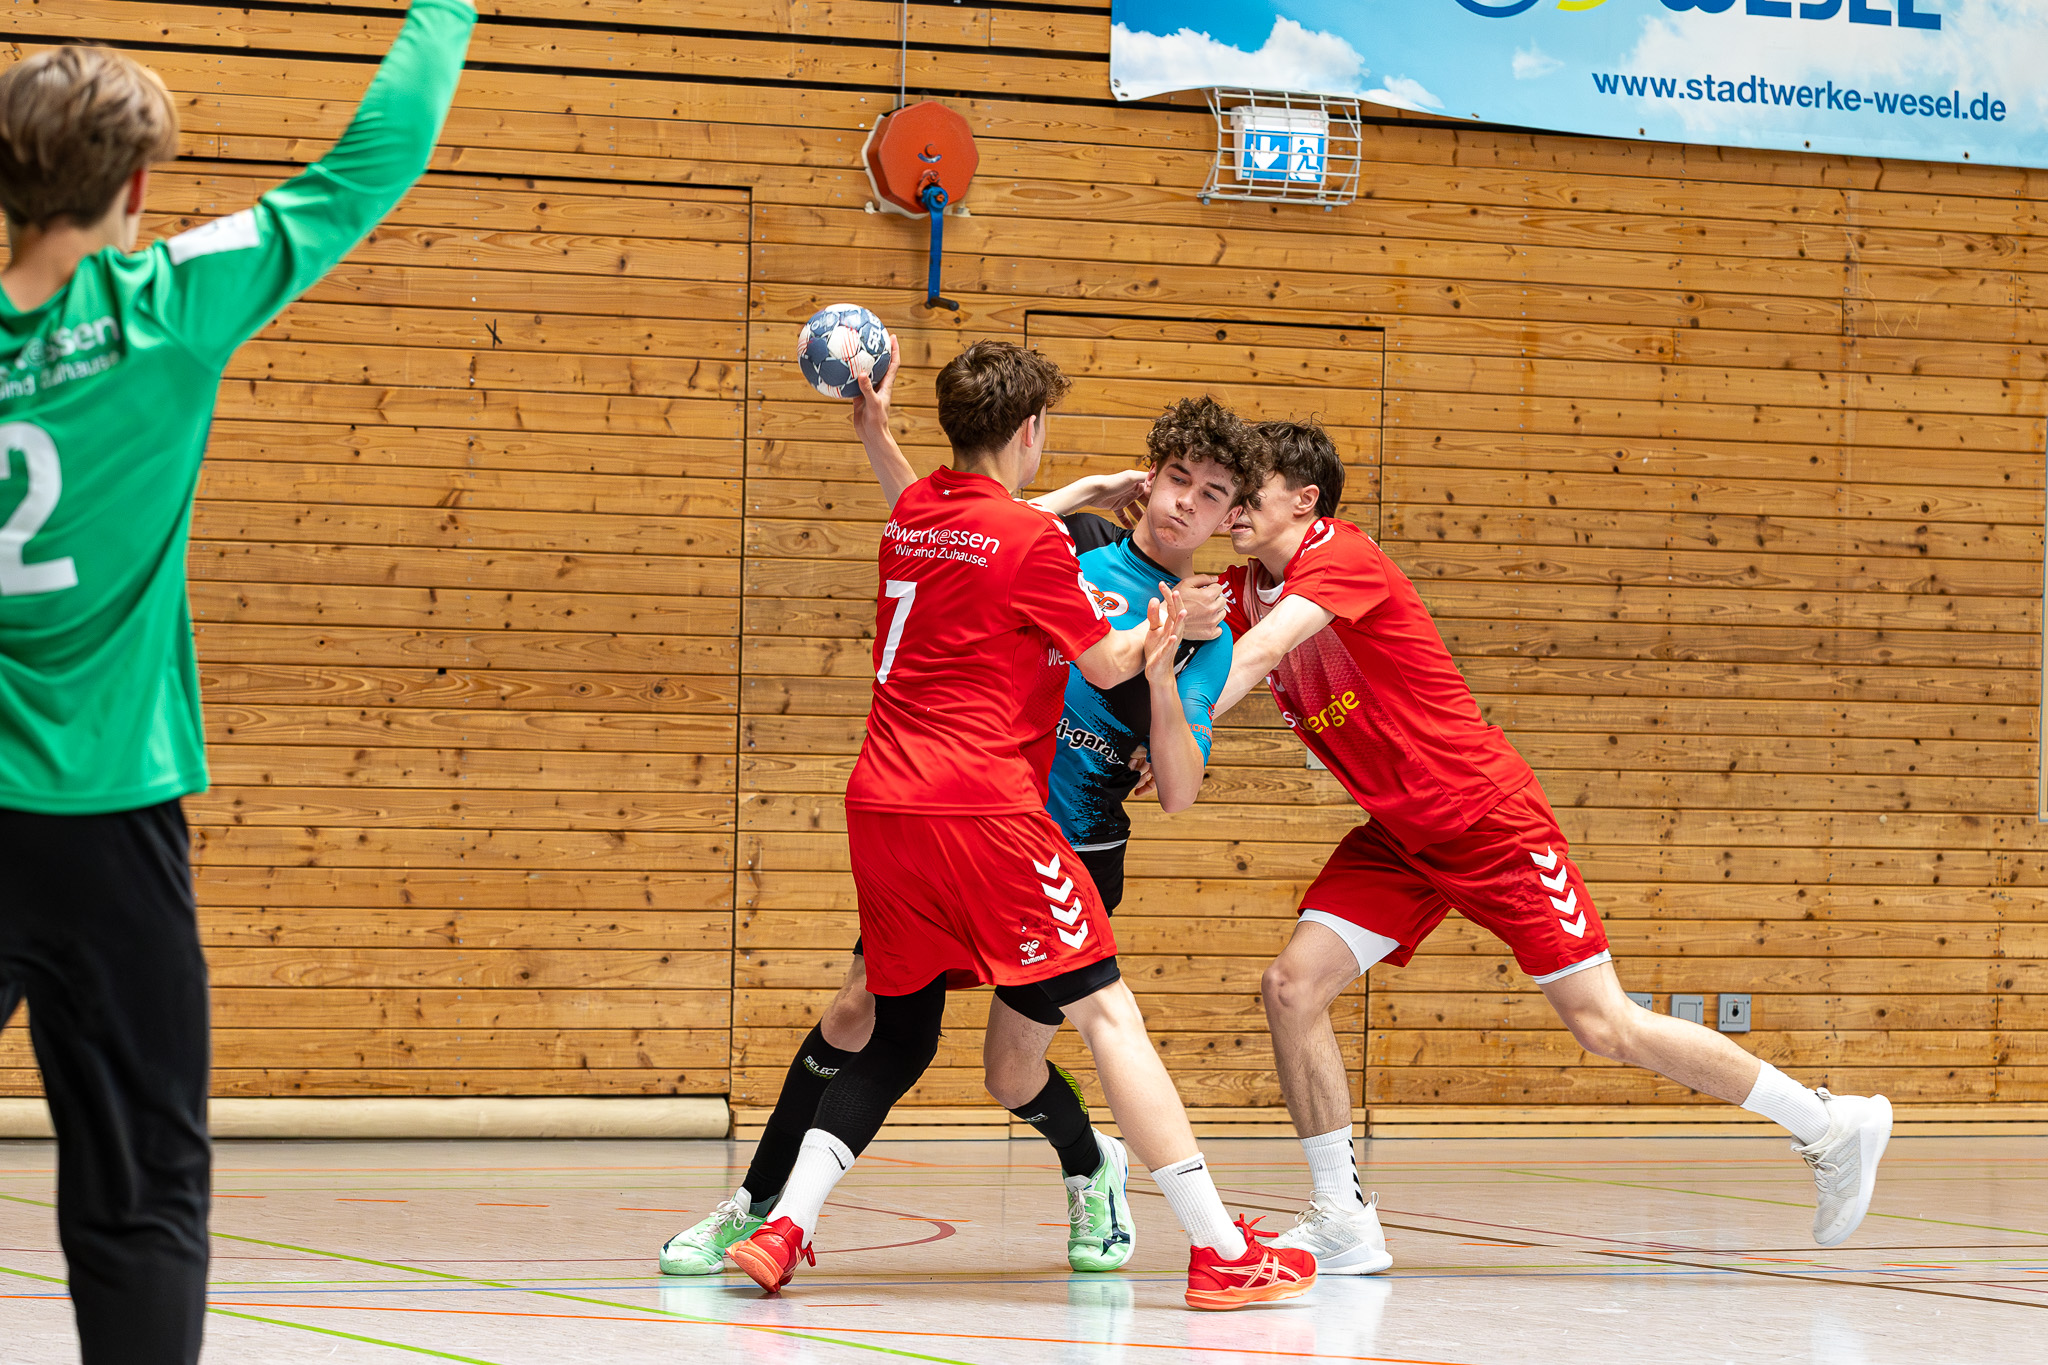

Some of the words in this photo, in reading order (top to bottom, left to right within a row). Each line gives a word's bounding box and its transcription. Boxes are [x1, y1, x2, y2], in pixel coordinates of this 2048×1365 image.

[1591, 72, 2007, 122] www.stadtwerke-wesel.de
[0, 421, 79, 596] 2
[883, 518, 1001, 555] dtwerkessen
[894, 544, 913, 557] Wir
[913, 546, 937, 559] sind
[937, 547, 989, 568] Zuhause.
[876, 579, 918, 685] 7
[1020, 952, 1048, 966] hummel
[804, 1055, 840, 1076] SELECT
